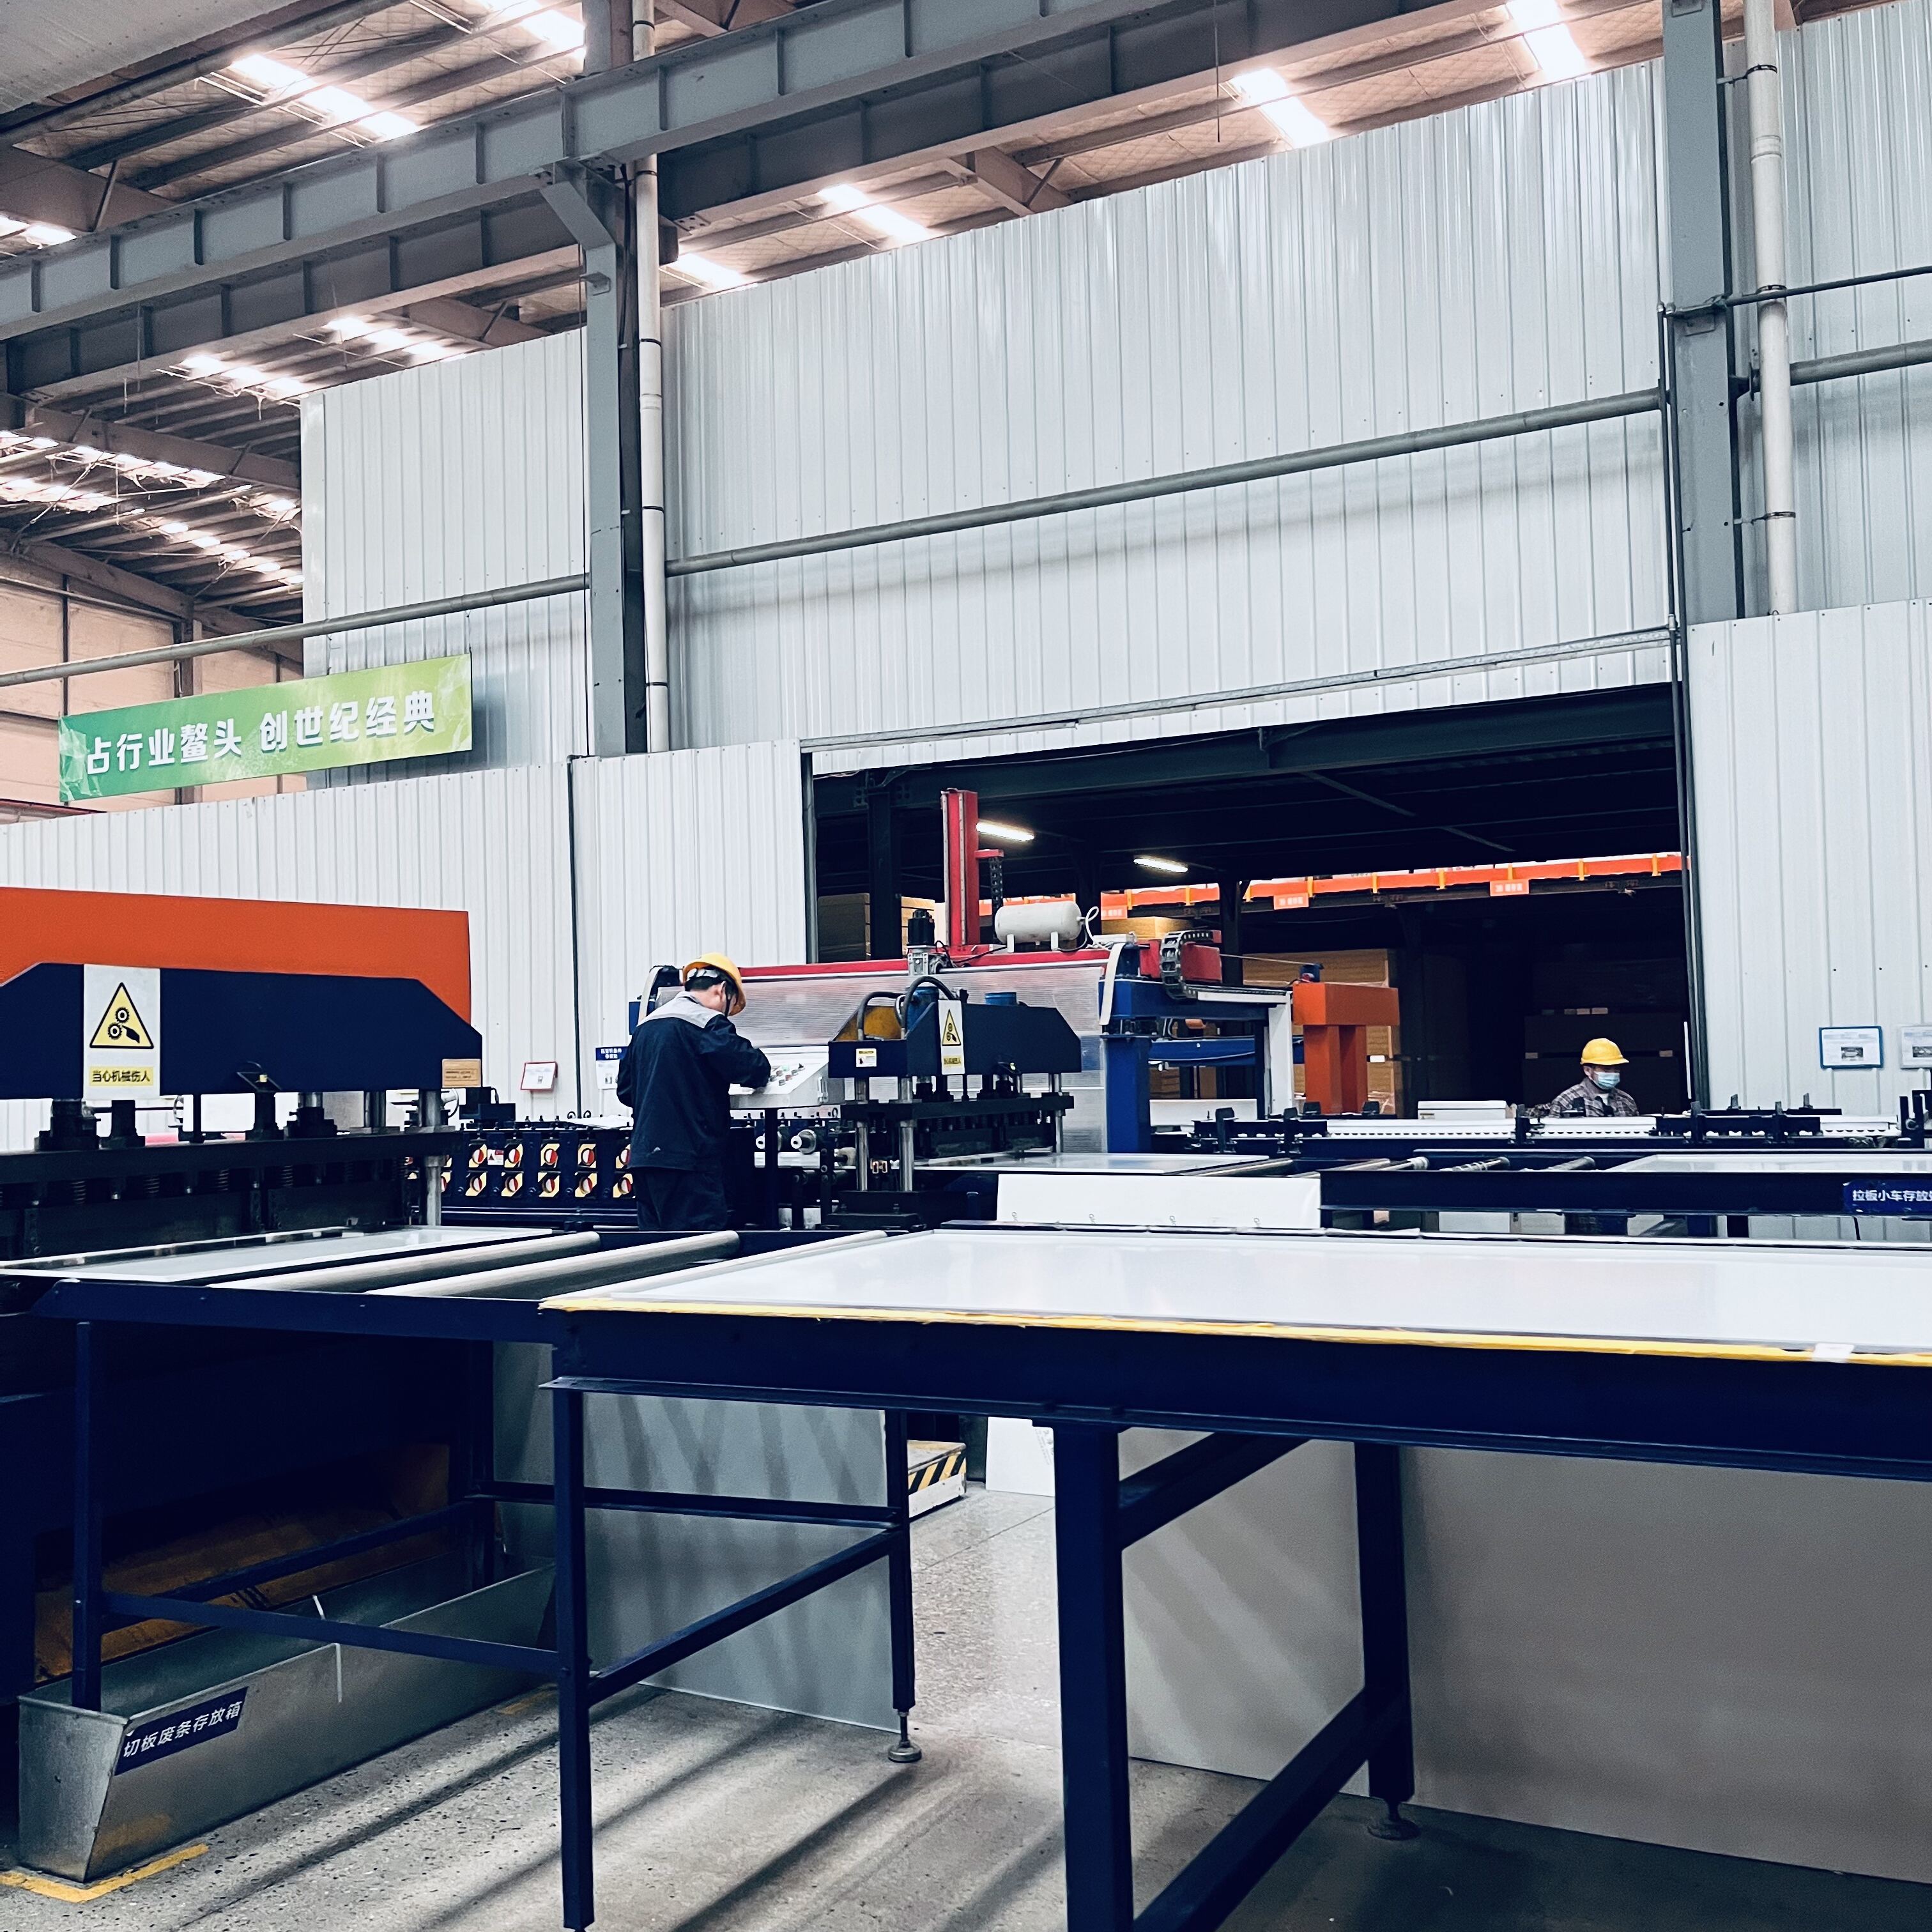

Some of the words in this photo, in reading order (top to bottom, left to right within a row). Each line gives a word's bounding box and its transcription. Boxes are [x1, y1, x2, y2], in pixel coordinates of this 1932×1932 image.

[87, 717, 241, 775] 占行业鳌头
[259, 689, 434, 752] 创世纪经典
[123, 1701, 243, 1758] 切板废条存放箱
